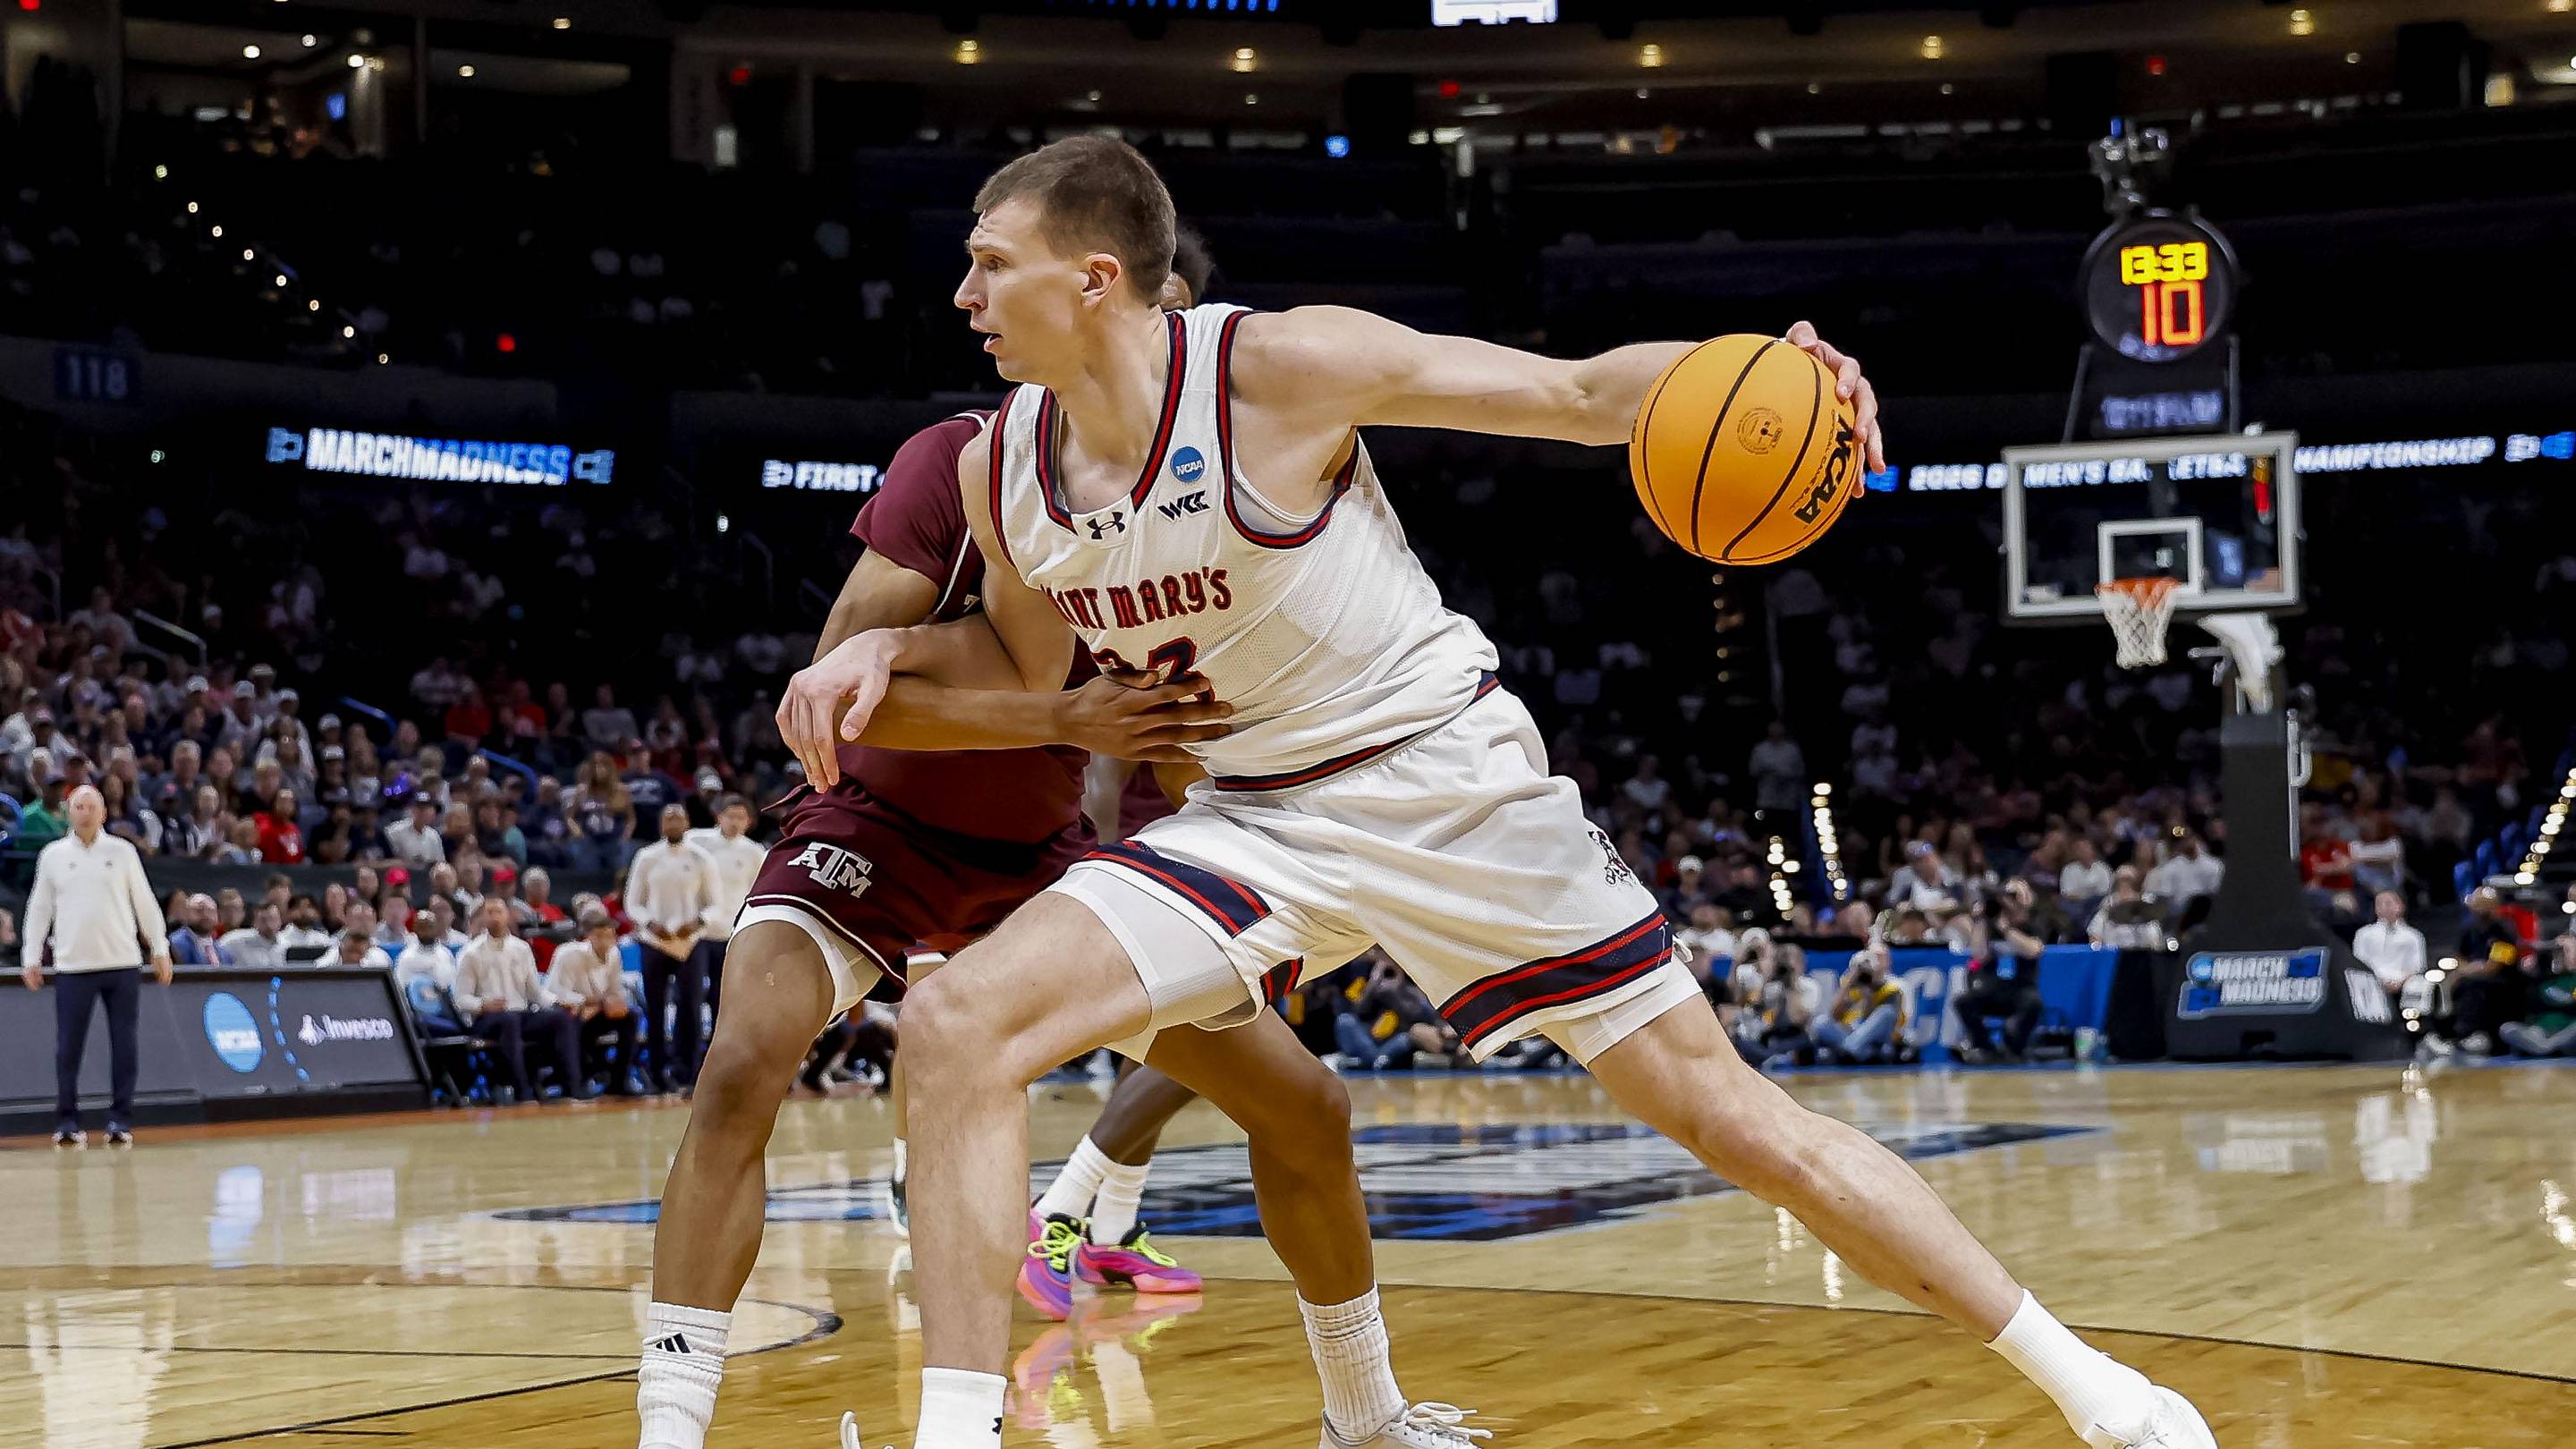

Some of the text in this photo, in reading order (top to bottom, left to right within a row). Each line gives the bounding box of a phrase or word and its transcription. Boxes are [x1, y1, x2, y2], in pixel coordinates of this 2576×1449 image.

[2121, 242, 2208, 285] 13:33
[2141, 281, 2206, 346] 10
[1175, 459, 1204, 476] NCAA
[1793, 413, 1854, 525] NCAA
[2292, 436, 2496, 473] HAMPIONSHIP
[794, 461, 878, 493] FIRST
[1157, 490, 1211, 521] WCC
[1106, 566, 1232, 629] MARY'S
[2212, 955, 2288, 981] MARCH
[2219, 977, 2326, 1007] MADNESS
